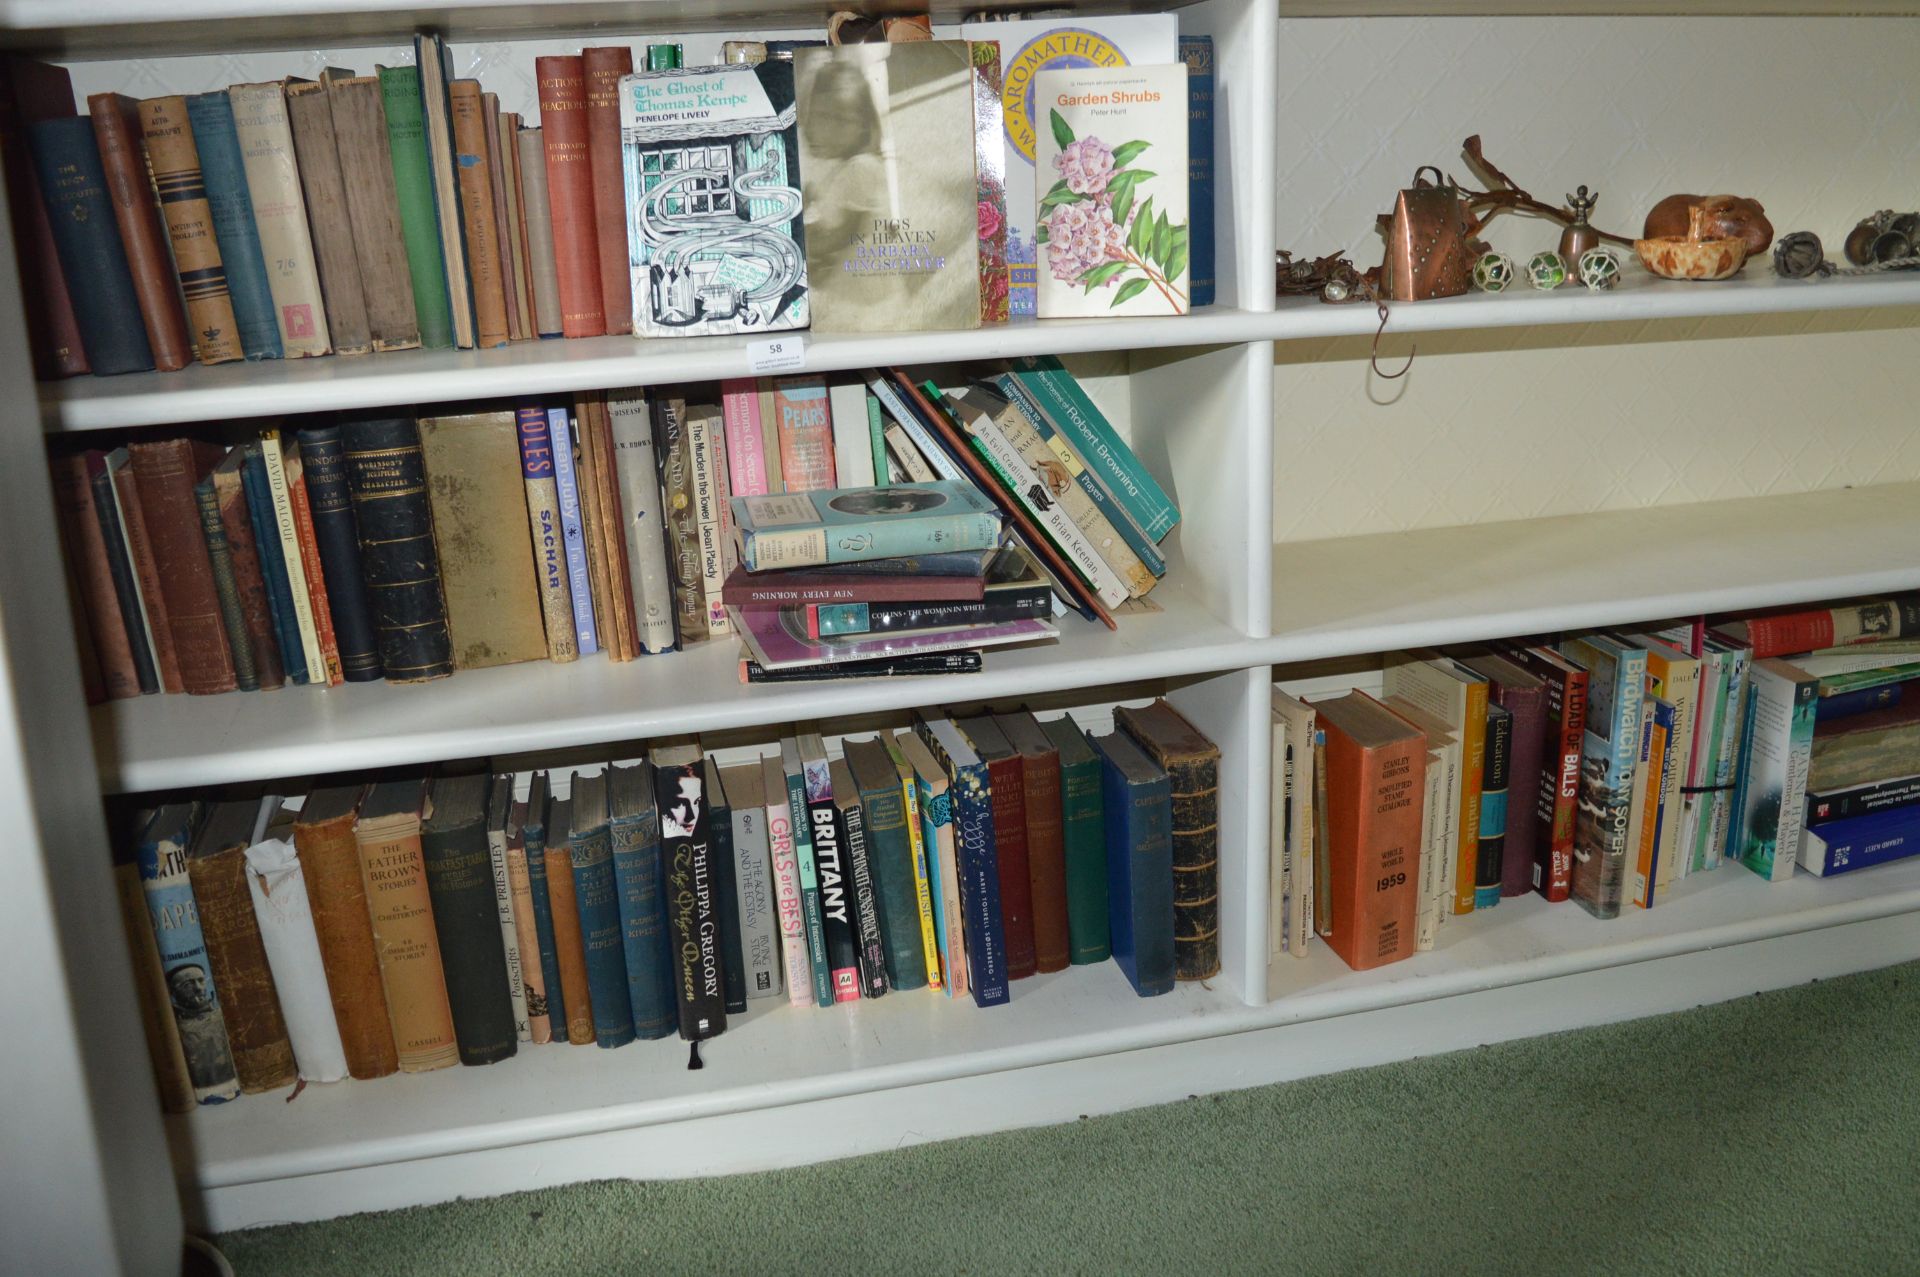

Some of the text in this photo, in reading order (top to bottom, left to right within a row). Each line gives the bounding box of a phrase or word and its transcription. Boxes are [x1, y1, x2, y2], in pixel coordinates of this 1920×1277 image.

[384, 88, 418, 97] RIDING
[632, 78, 726, 99] The Ghost of
[1057, 90, 1161, 106] Garden Shrubs
[635, 94, 749, 113] Thomas Kempe
[635, 110, 711, 123] PENELOPE LIVELY
[873, 217, 912, 231] PIGS
[848, 230, 937, 245] IN HEAVEN
[857, 244, 931, 258] BARBARA
[843, 256, 946, 272] KINGSOLVER
[769, 344, 784, 354] 58
[1005, 379, 1034, 414] COMPANION
[783, 405, 826, 429] PEARS
[1011, 394, 1041, 433] LECTIONARY
[520, 406, 552, 473] HOLES
[692, 424, 703, 441] The
[664, 406, 685, 491] JEAN PLAIDY
[694, 442, 706, 467] Murder
[978, 423, 1029, 488] An Evil Cradling
[1060, 450, 1072, 463] 3
[1064, 404, 1100, 448] Robert
[1095, 443, 1140, 498] Browning
[699, 478, 709, 493] the
[1080, 474, 1104, 502] Prayers
[266, 451, 294, 544] DAVID MALOUF
[700, 494, 712, 523] Tower
[540, 509, 560, 589] SACHAR
[703, 525, 718, 580] Jean Plaidy
[1050, 514, 1100, 575] Brian Keenan
[751, 588, 854, 602] NEW EVERY MORNING
[871, 608, 901, 619] COLLINS
[906, 607, 921, 617] THE
[923, 605, 949, 615] WOMAN
[958, 602, 985, 612] WHITE
[1570, 681, 1584, 692] A
[1567, 693, 1583, 730] LOAD
[1668, 697, 1685, 756] WINDING
[1567, 732, 1580, 750] OF
[1382, 756, 1410, 771] STANLEY
[1471, 737, 1483, 768] The
[1609, 658, 1644, 857] Birdwatch TONY SOPER
[1381, 764, 1410, 780] GIBBONS
[1561, 753, 1579, 798] BALLS
[1786, 750, 1799, 804] Gentlemen
[1377, 780, 1413, 797] SIMPLIFIED
[1383, 790, 1405, 803] STAMP
[1657, 771, 1667, 804] LONDON
[1860, 787, 1909, 802] Thermodynamics
[1377, 797, 1412, 814] CATALOGUE
[1784, 736, 1812, 865] JOANNE HARRIS
[1866, 797, 1894, 809] Chemical
[962, 812, 986, 857] hygge
[1777, 820, 1790, 856] Players
[380, 843, 401, 854] THE
[1381, 847, 1404, 860] WHOLE
[367, 852, 419, 870] FATHER
[491, 842, 507, 902] PRIESTLEY
[802, 859, 812, 873] 4
[812, 808, 848, 925] BRITTANY
[1381, 856, 1405, 869] WORLD
[1551, 850, 1562, 878] SCALLY
[370, 864, 421, 882] BROWN
[978, 870, 987, 891] MARIE
[1375, 871, 1407, 892] 1959
[376, 877, 417, 892] STORIES
[739, 848, 758, 929] AND THE ECSTASY
[752, 858, 768, 915] THE AGONY
[807, 892, 817, 917] Prayers
[916, 881, 933, 922] MUSIC
[980, 893, 990, 927] TOURELL
[378, 907, 428, 922] CHESTERTON
[691, 843, 718, 998] PHILIPPA GREGORY
[750, 937, 762, 968] STONE
[759, 934, 772, 965] IRVING
[508, 947, 522, 998] Postscripts
[840, 976, 852, 984] AA
[407, 1036, 443, 1048] CASSELL
